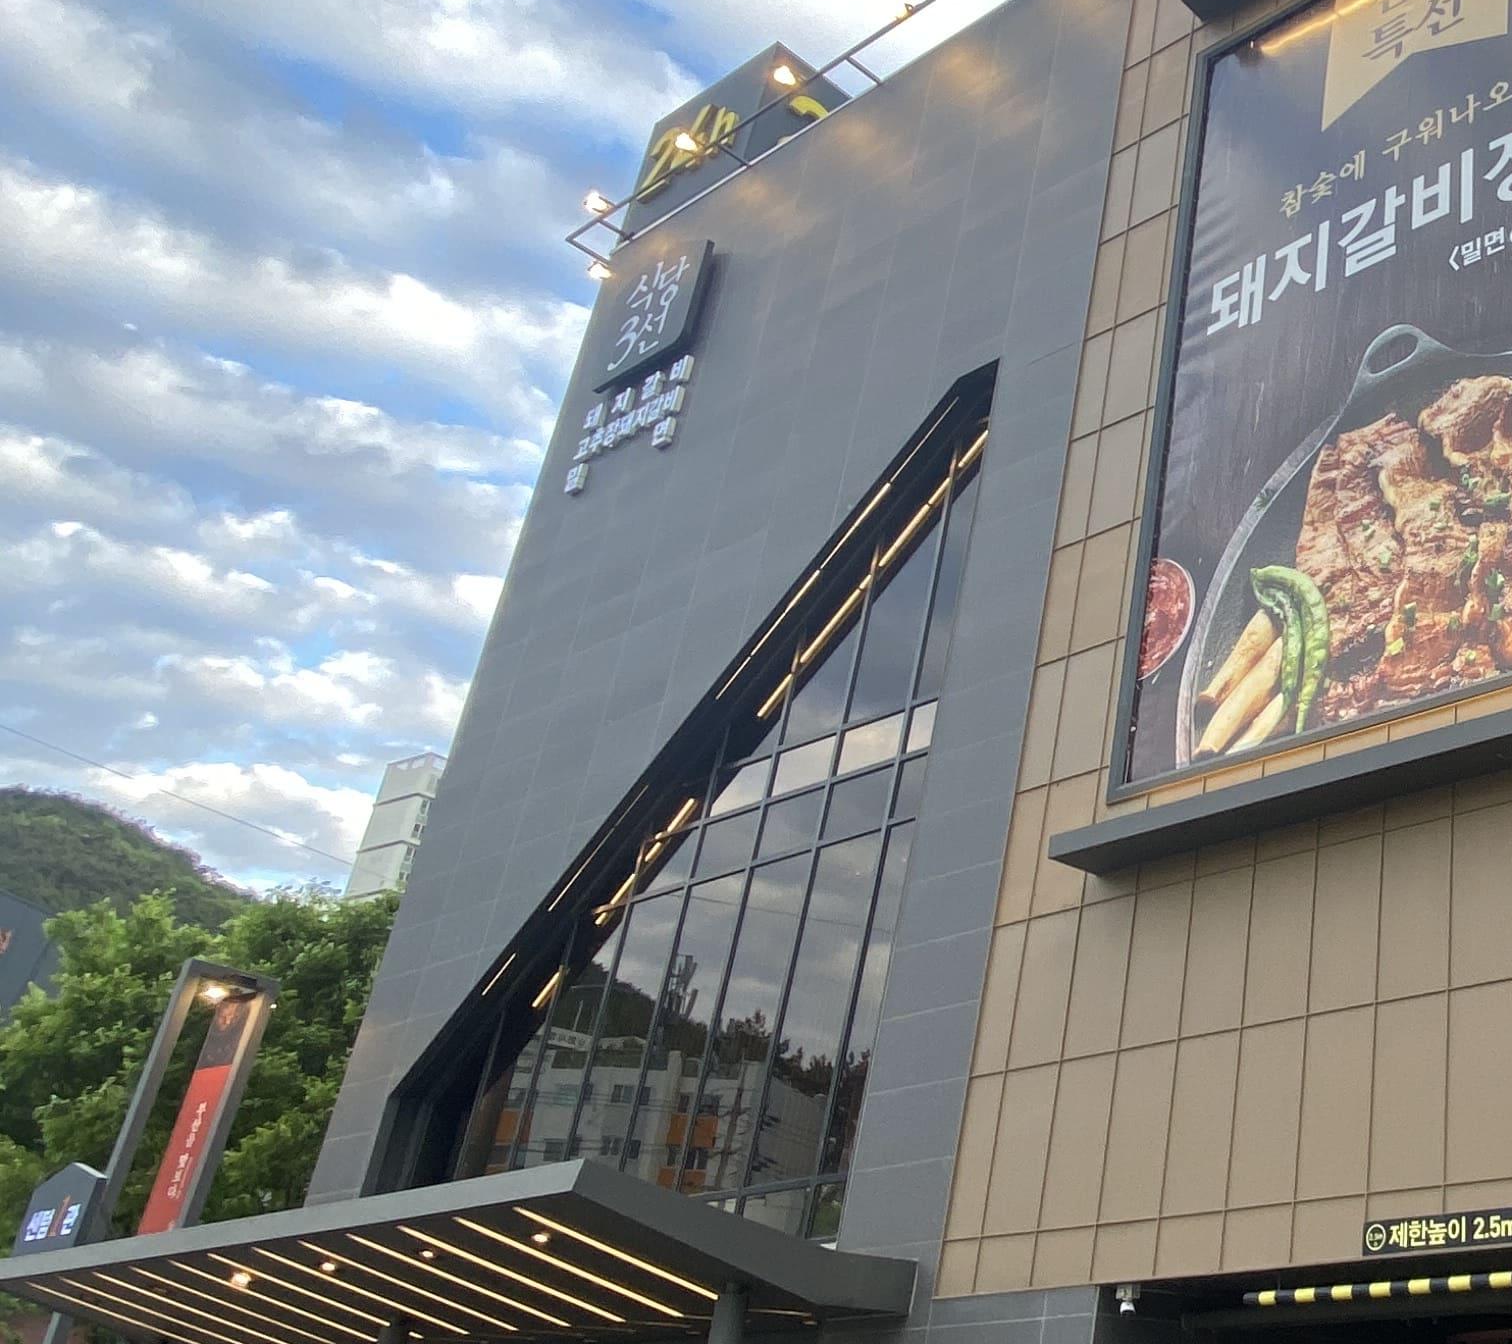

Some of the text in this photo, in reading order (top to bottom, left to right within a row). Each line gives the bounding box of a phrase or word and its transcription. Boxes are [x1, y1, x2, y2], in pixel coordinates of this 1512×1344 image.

[1280, 149, 1366, 218] 참숯에
[626, 255, 690, 311] 식당
[1389, 1216, 1466, 1248] 제한높이
